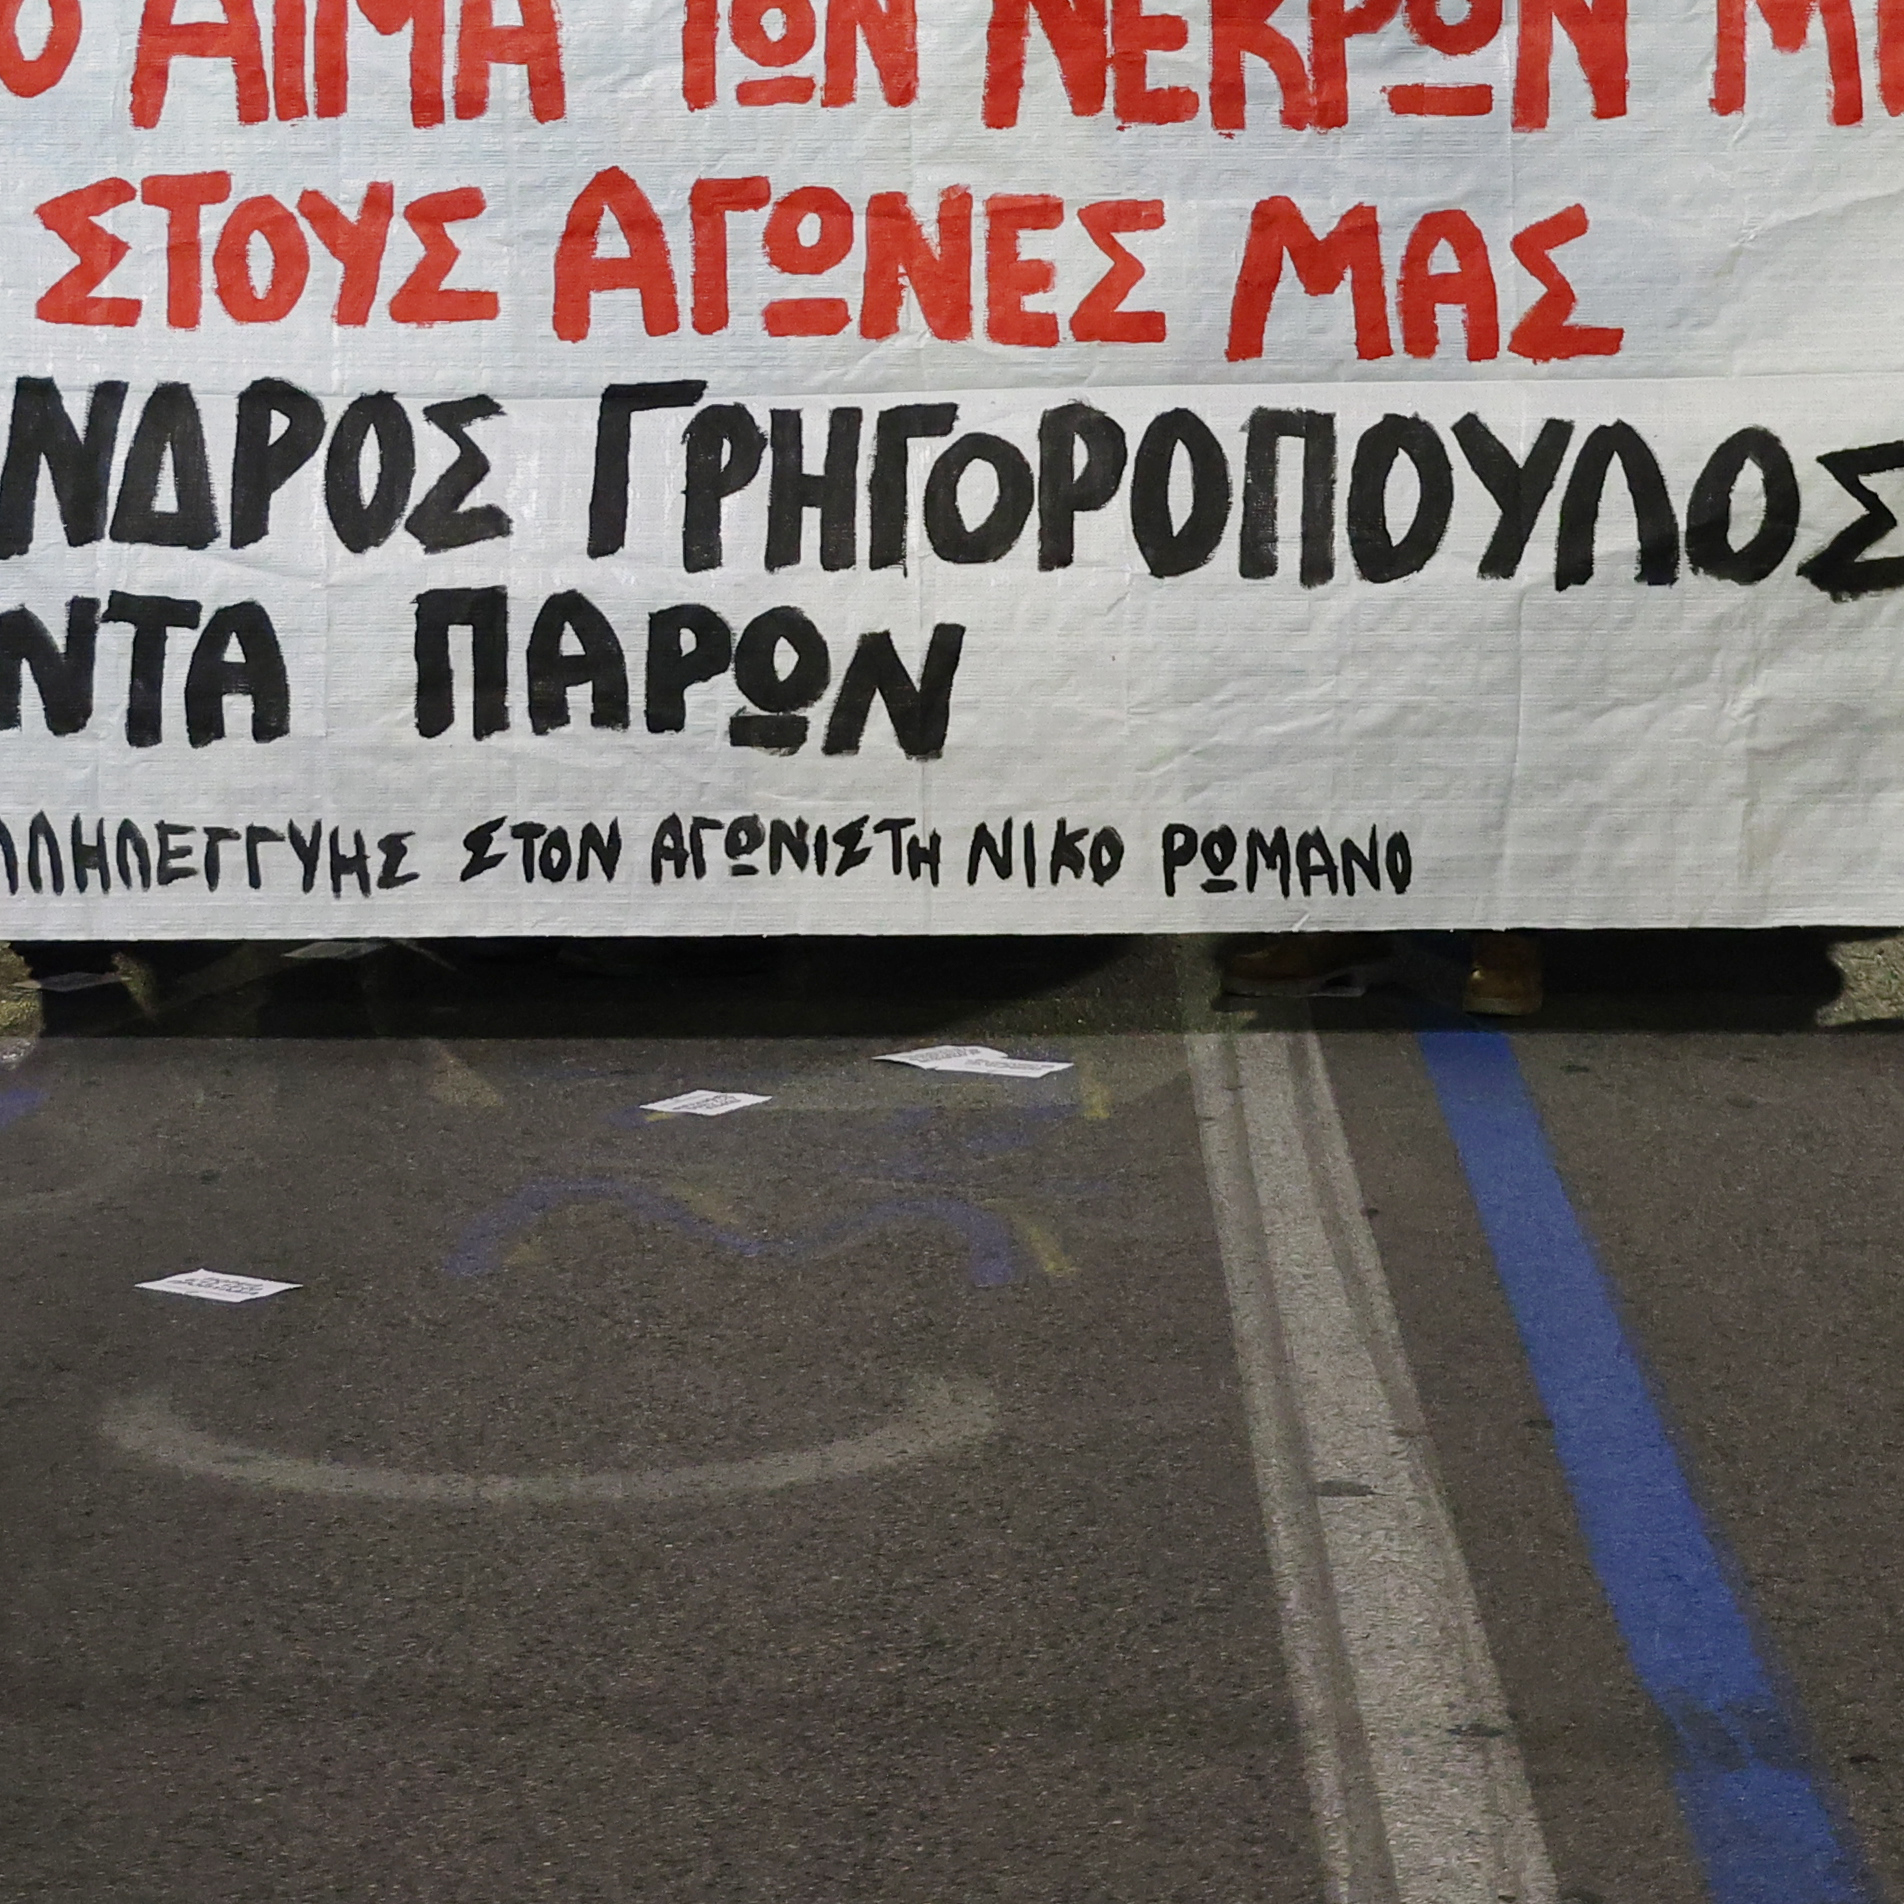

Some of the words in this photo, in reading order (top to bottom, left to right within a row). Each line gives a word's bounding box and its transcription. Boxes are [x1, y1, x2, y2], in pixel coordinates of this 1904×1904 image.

[36, 171, 498, 328] ΣΤΟΥΣ
[554, 167, 1166, 347] ΑΓΩΝΕΣ
[1226, 196, 1623, 362] ΜΑΣ
[411, 586, 965, 762] ΠΑΡΩΝ
[460, 816, 621, 883] ΣΤΟΝ
[651, 813, 941, 887] ΑΓΩΝΙΣΤΗ
[968, 817, 1124, 888] ΝΙΚΟ
[1162, 824, 1412, 899] ΡΩΜΑΝΟ
